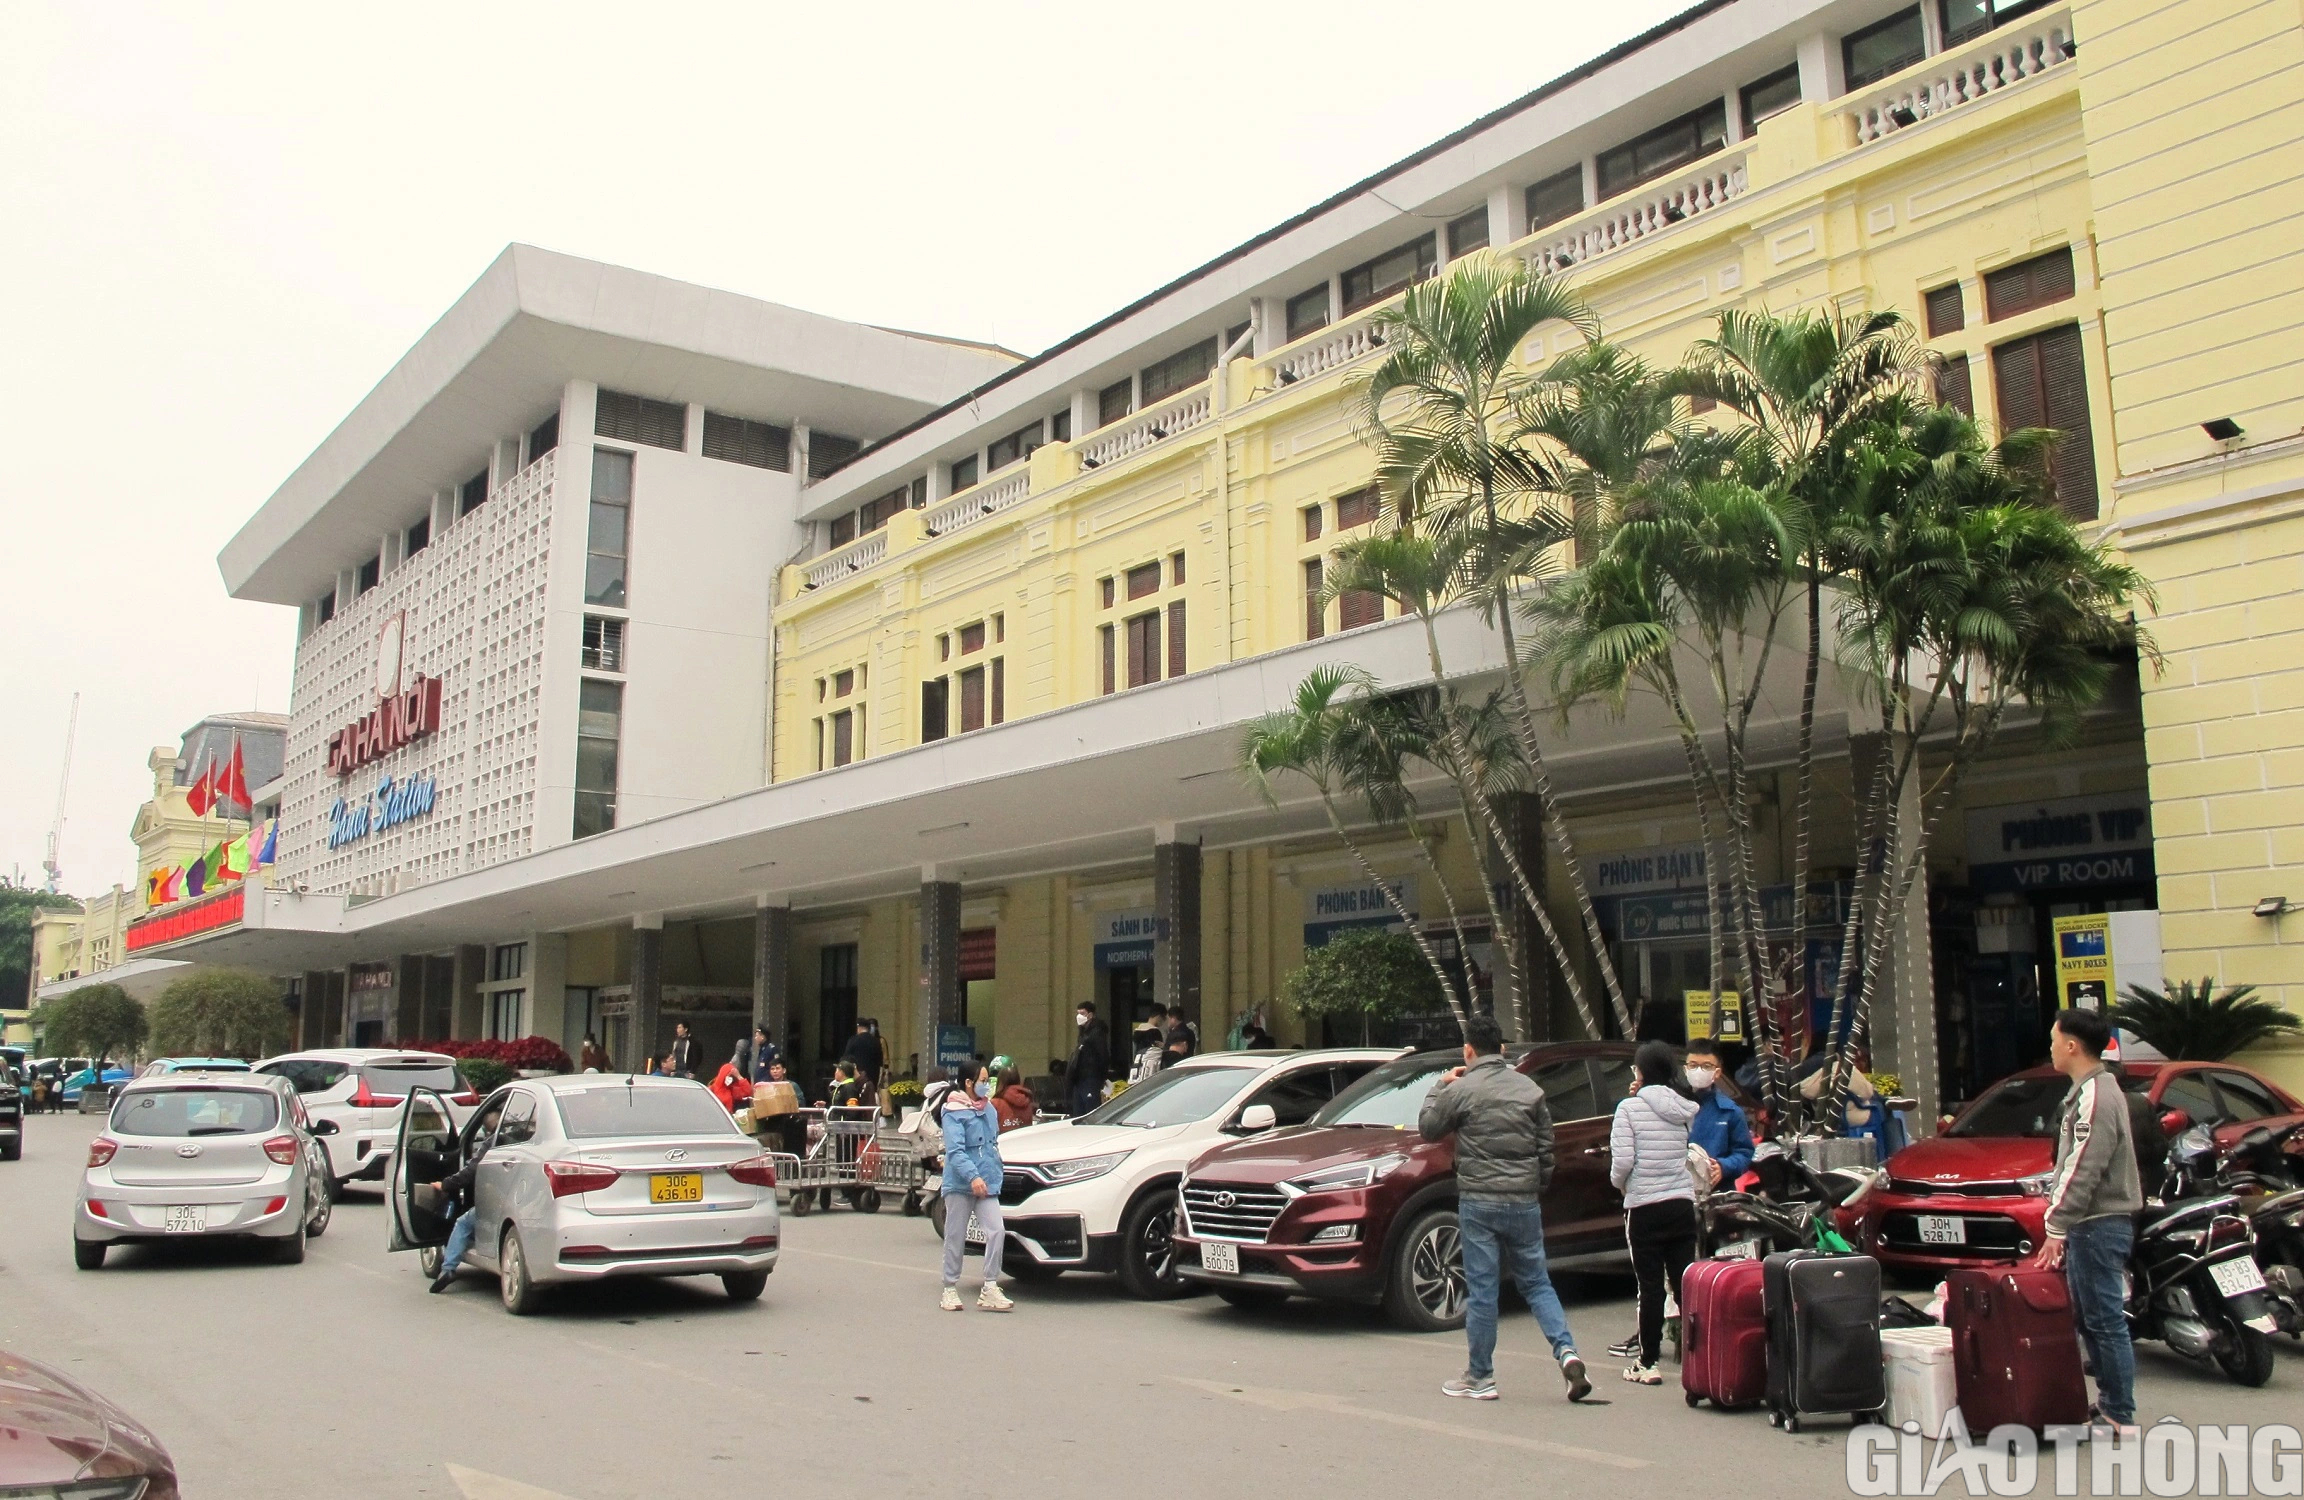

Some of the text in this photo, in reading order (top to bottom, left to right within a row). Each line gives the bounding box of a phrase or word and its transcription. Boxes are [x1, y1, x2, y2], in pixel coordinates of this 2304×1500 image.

[328, 772, 436, 850] Hanoi Station
[2097, 807, 2145, 841] VIP
[1600, 849, 1707, 887] PHÒNG BÁN V
[2013, 857, 2134, 885] VIP ROOM
[1316, 888, 1357, 915] PHÒNG
[1360, 884, 1385, 911] BÁN
[2085, 922, 2108, 930] LOCKER
[1107, 950, 1148, 963] NORTHERN
[2061, 958, 2107, 970] NAVY BOXES
[666, 1176, 688, 1188] 30G
[656, 1188, 698, 1201] 436.19
[176, 1206, 197, 1219] 30E
[1930, 1218, 1951, 1230] 30H
[1923, 1230, 1960, 1243] 528.71
[1211, 1244, 1227, 1257] 30G
[1205, 1256, 1235, 1271] 500.79
[2217, 1260, 2251, 1280] 15-B3
[2219, 1272, 2262, 1294] 534.74
